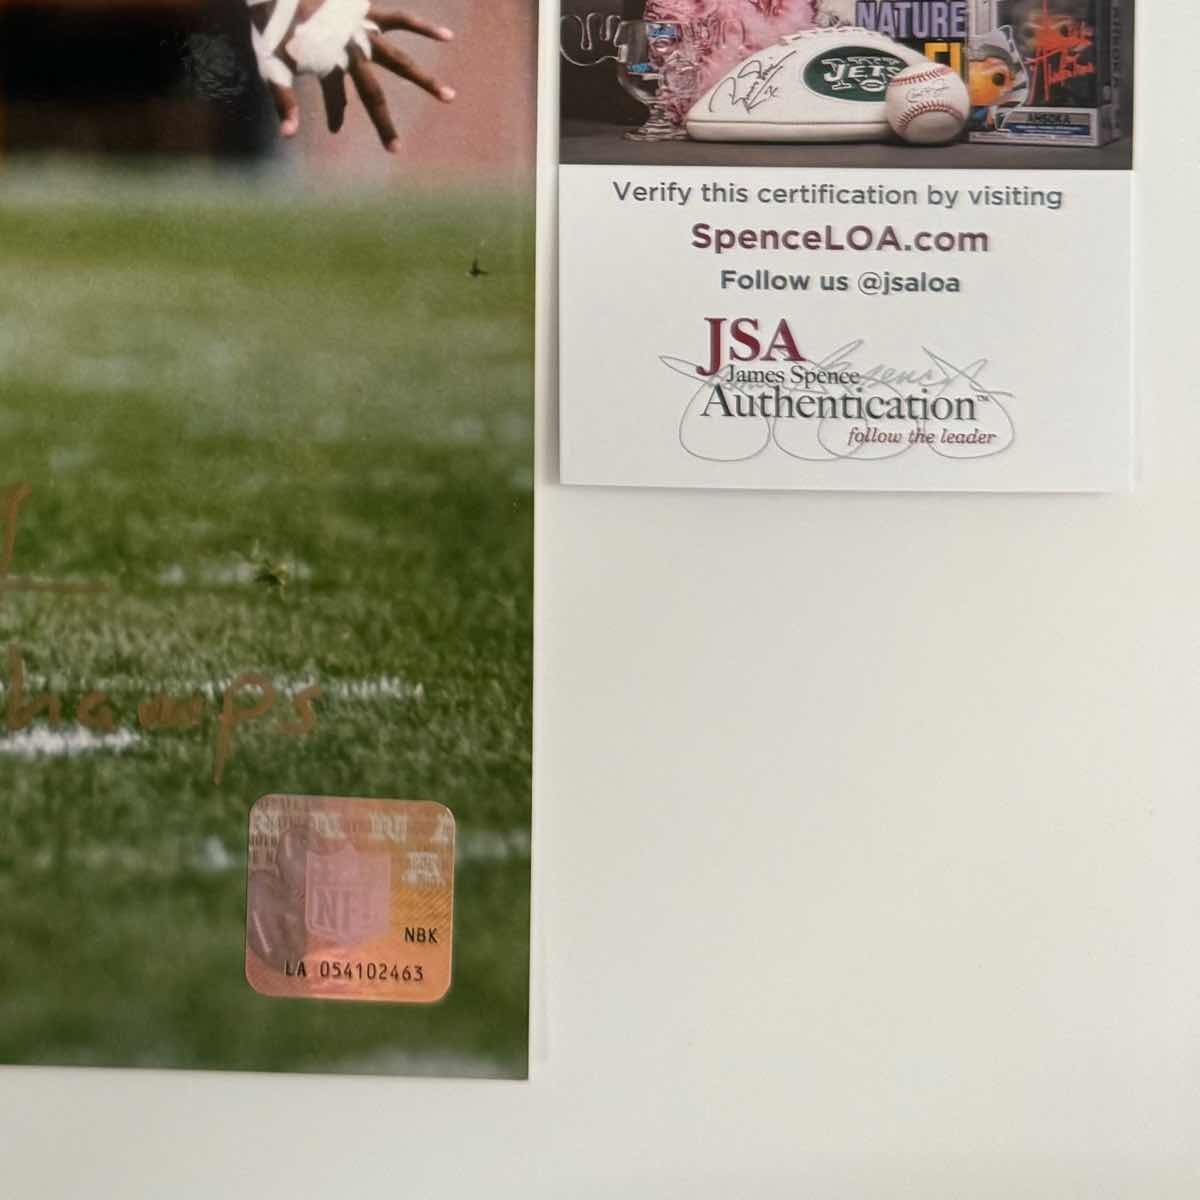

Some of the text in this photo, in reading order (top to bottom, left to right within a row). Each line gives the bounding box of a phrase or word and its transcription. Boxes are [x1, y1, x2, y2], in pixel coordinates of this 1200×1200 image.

[856, 0, 968, 39] NATURE
[613, 181, 1063, 210] Verify this certification by visiting
[692, 223, 989, 254] SpenceLOA.com
[721, 270, 960, 296] Follow us @jsaloa
[696, 317, 807, 376] JSA
[725, 364, 860, 389] James Spence
[848, 427, 997, 446] follow the leader
[404, 928, 438, 944] NBK
[285, 961, 424, 982] LA 054102463
